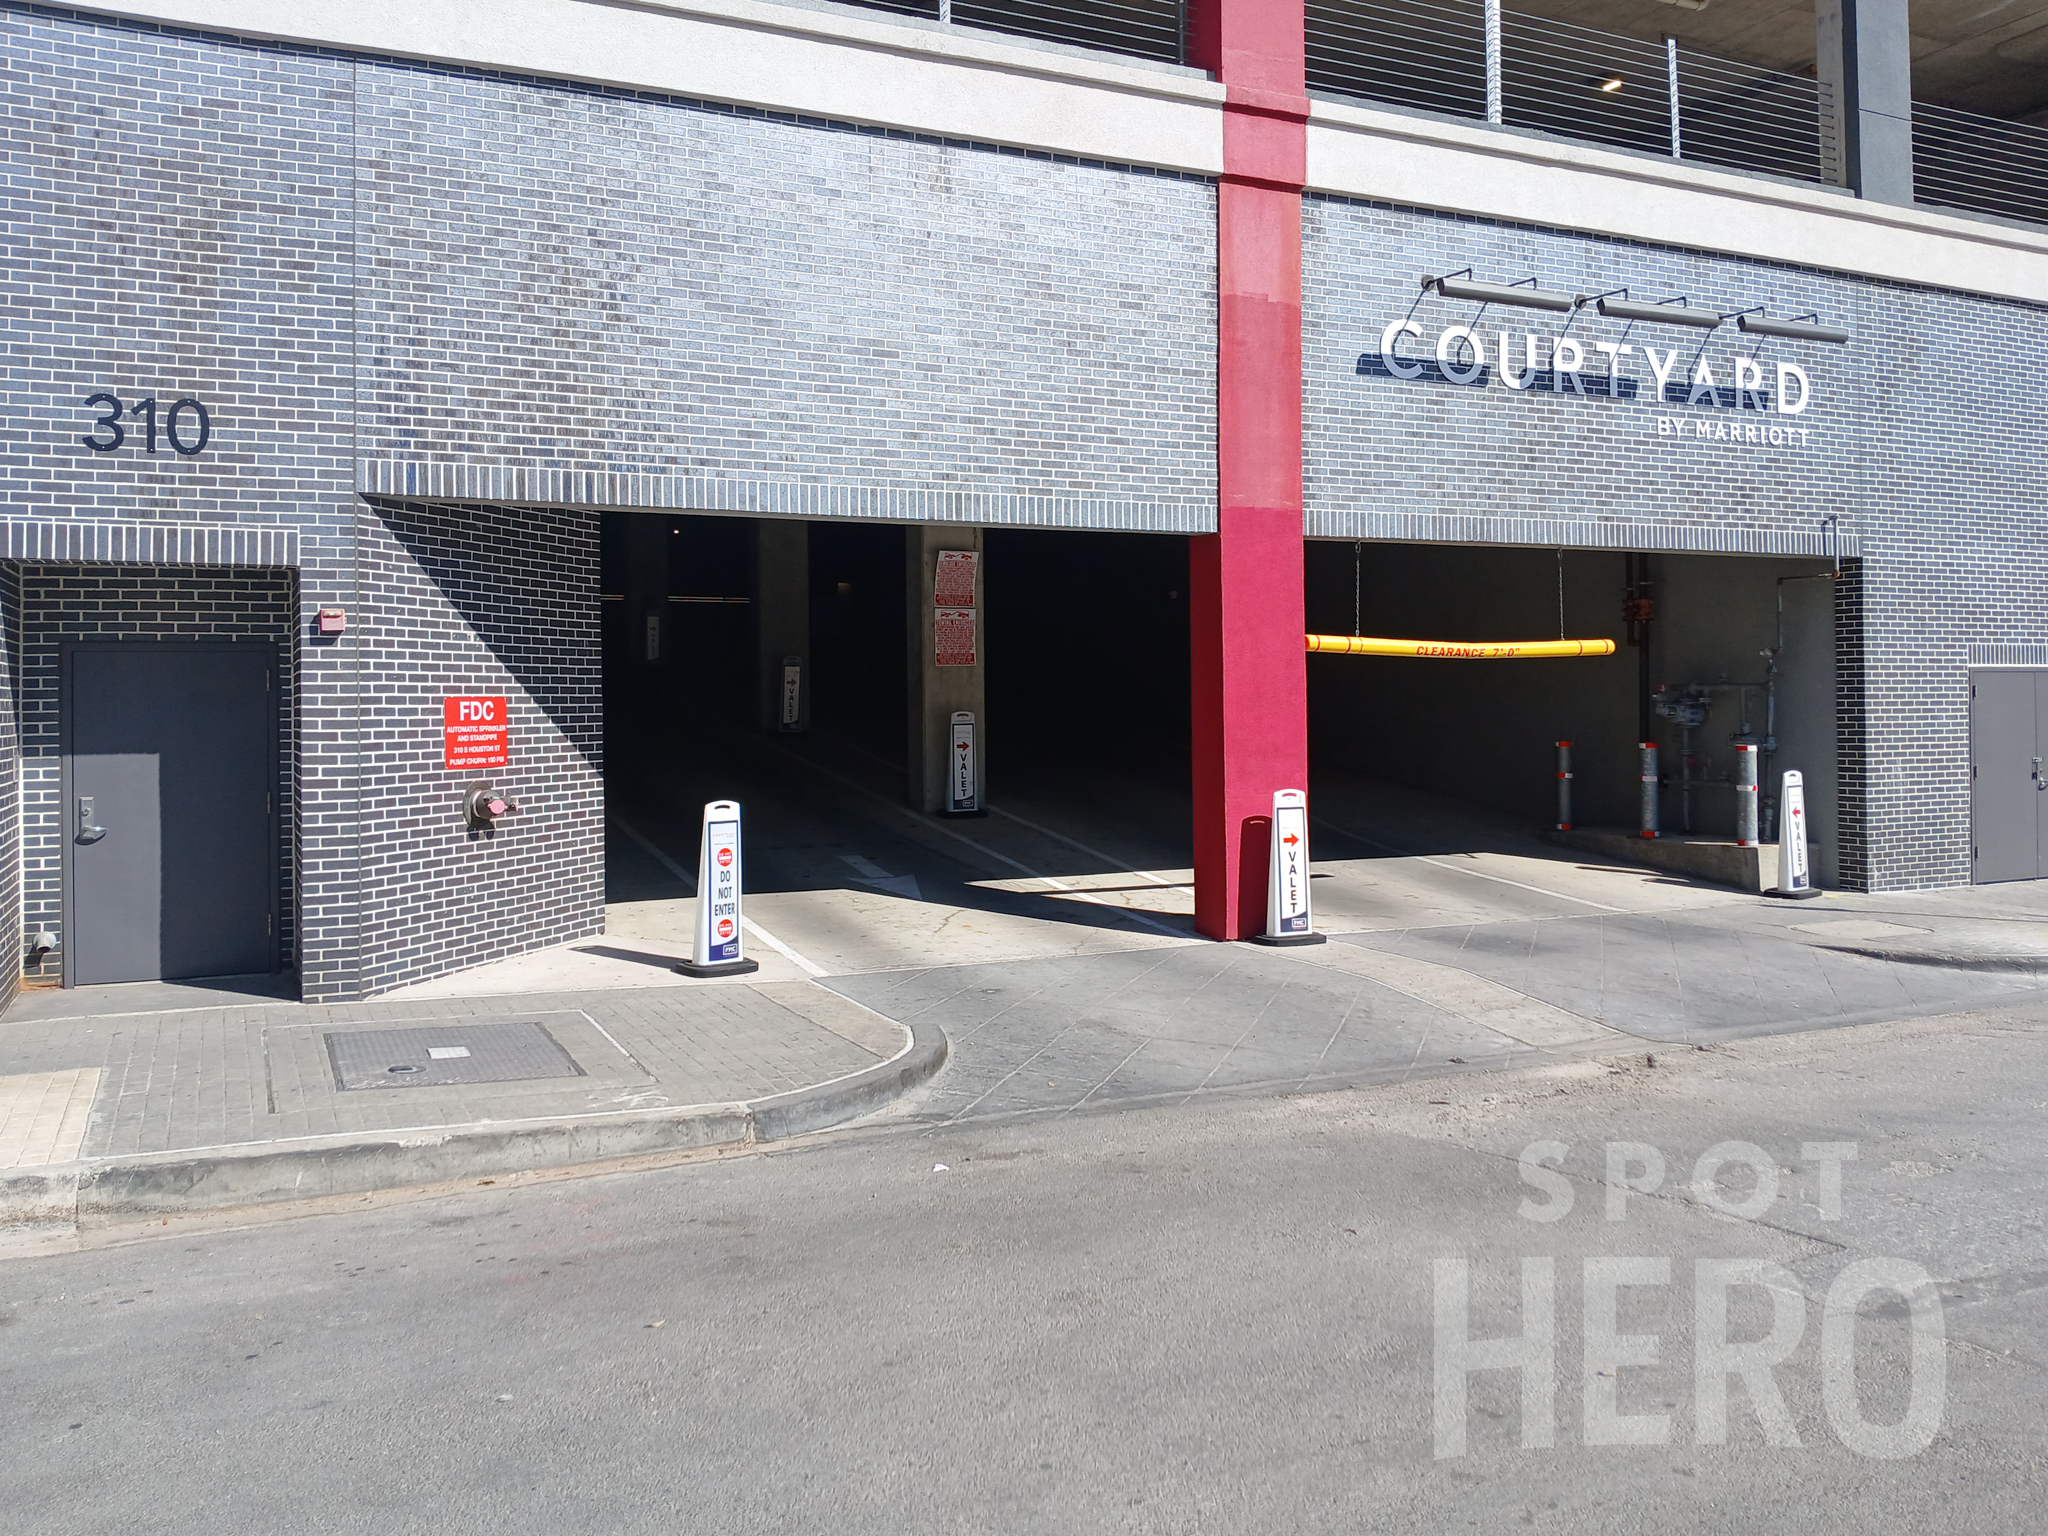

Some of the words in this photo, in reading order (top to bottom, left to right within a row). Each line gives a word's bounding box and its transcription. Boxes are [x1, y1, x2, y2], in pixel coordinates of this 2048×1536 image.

[1380, 319, 1810, 416] COURTYARD
[82, 393, 210, 455] 310
[1657, 417, 1685, 437] BY
[1695, 420, 1809, 447] MARRIOTT
[1416, 646, 1486, 658] CLEARANCE
[460, 701, 494, 721] FDC
[446, 725, 478, 733] AUTOMATIC
[479, 724, 506, 732] SPRINKLER
[457, 734, 469, 742] AND
[469, 733, 498, 741] STANDPIPE
[468, 745, 494, 753] HOUSTON
[449, 758, 466, 766] PUMP
[1795, 821, 1803, 873] VALET
[720, 870, 731, 882] DO
[1288, 851, 1297, 914] VALET
[718, 886, 732, 899] NOT
[714, 902, 735, 916] ENTER
